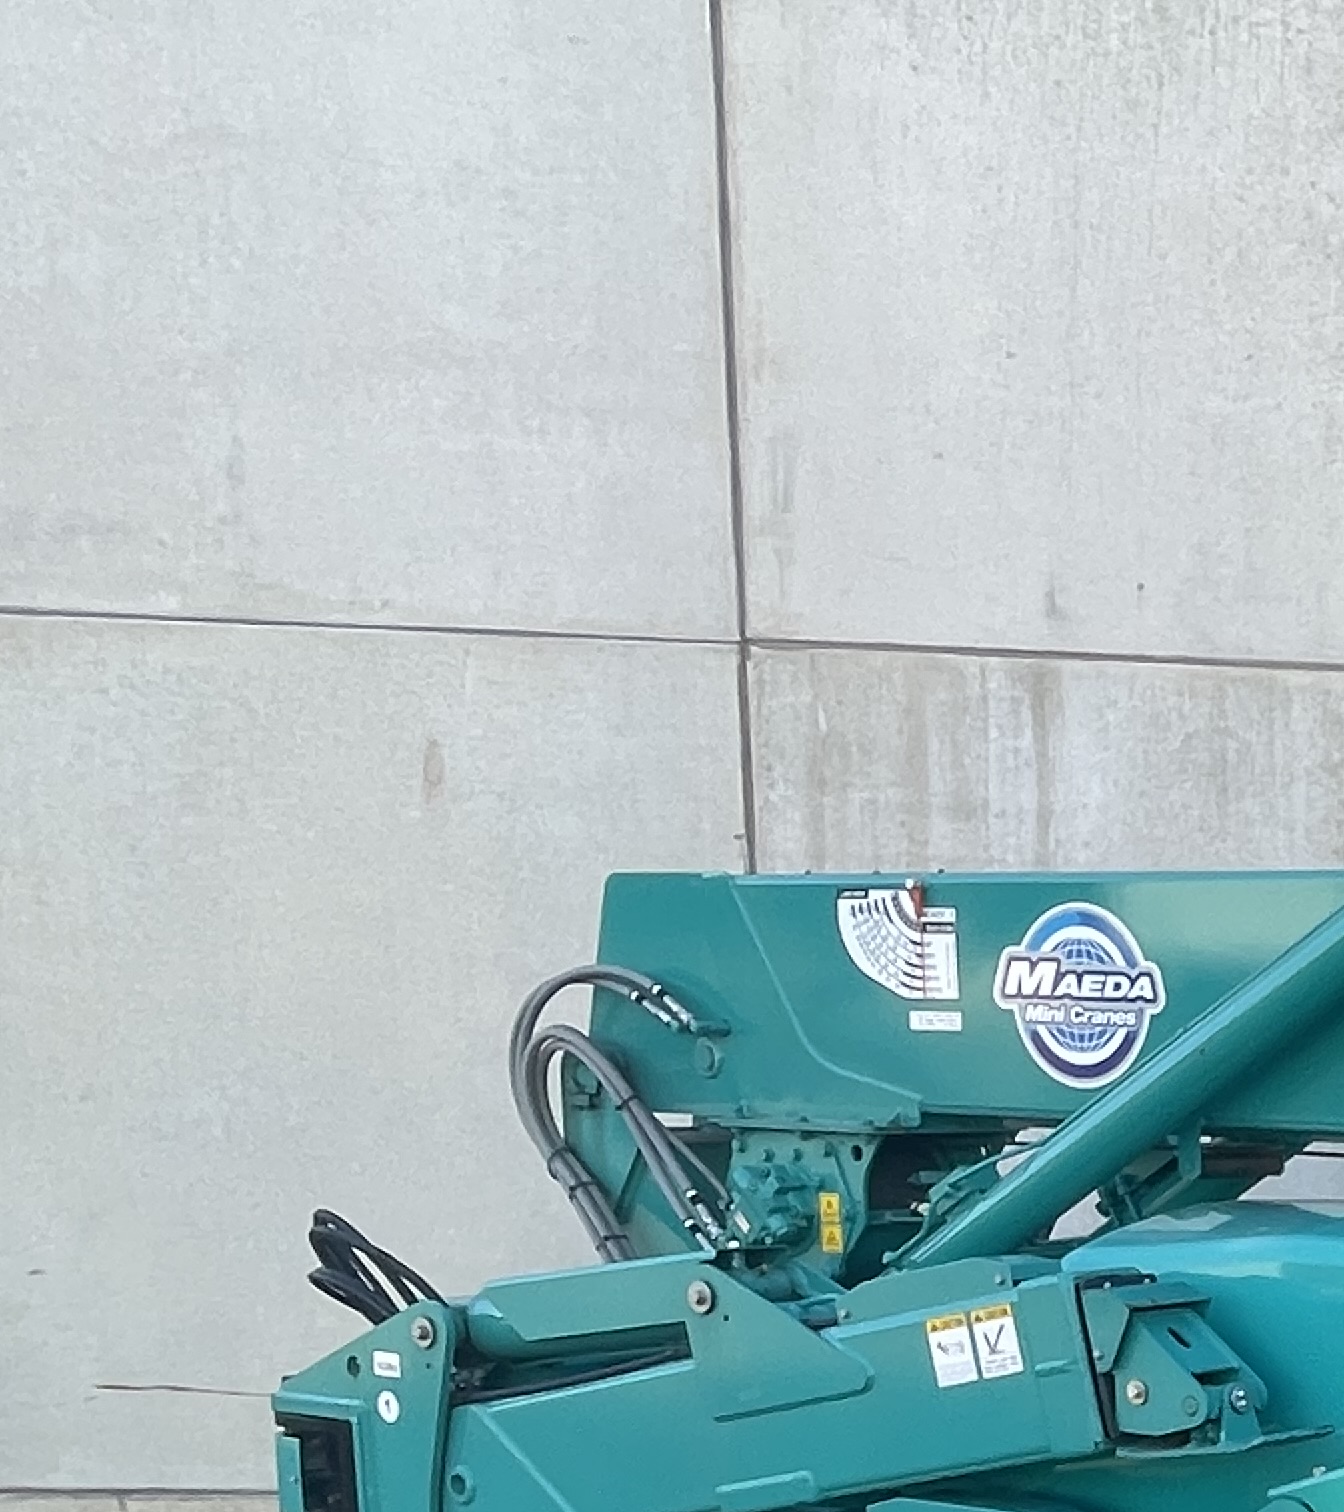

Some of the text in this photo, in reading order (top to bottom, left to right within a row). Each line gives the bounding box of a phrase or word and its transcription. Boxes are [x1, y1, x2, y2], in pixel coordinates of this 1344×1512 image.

[1004, 956, 1157, 1001] MAEDA
[1024, 1004, 1137, 1027] Mini Cranes
